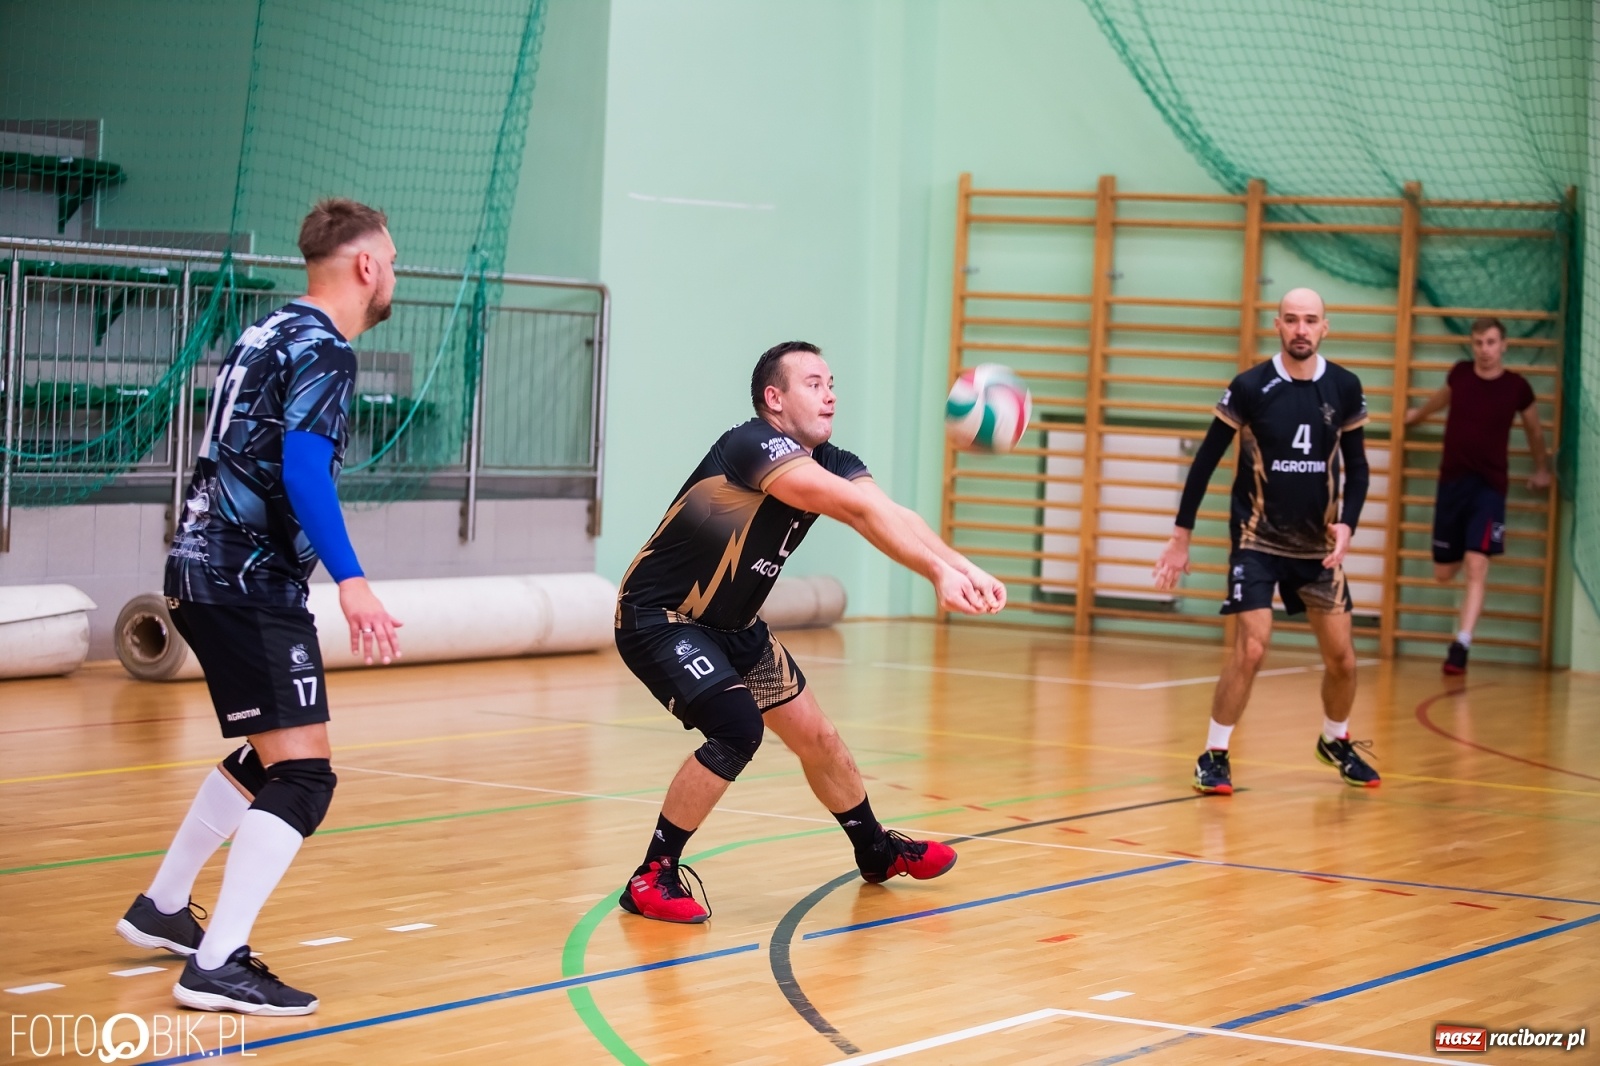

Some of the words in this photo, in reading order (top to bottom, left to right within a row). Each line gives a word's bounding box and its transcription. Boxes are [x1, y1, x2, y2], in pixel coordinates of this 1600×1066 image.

[760, 436, 785, 450] DARK
[1291, 424, 1312, 455] 4
[768, 442, 789, 454] SIDE
[1271, 459, 1326, 473] AGROTIM
[1233, 583, 1242, 601] 4
[683, 655, 715, 680] 10
[292, 676, 318, 707] 17
[226, 707, 261, 721] AGROTIM
